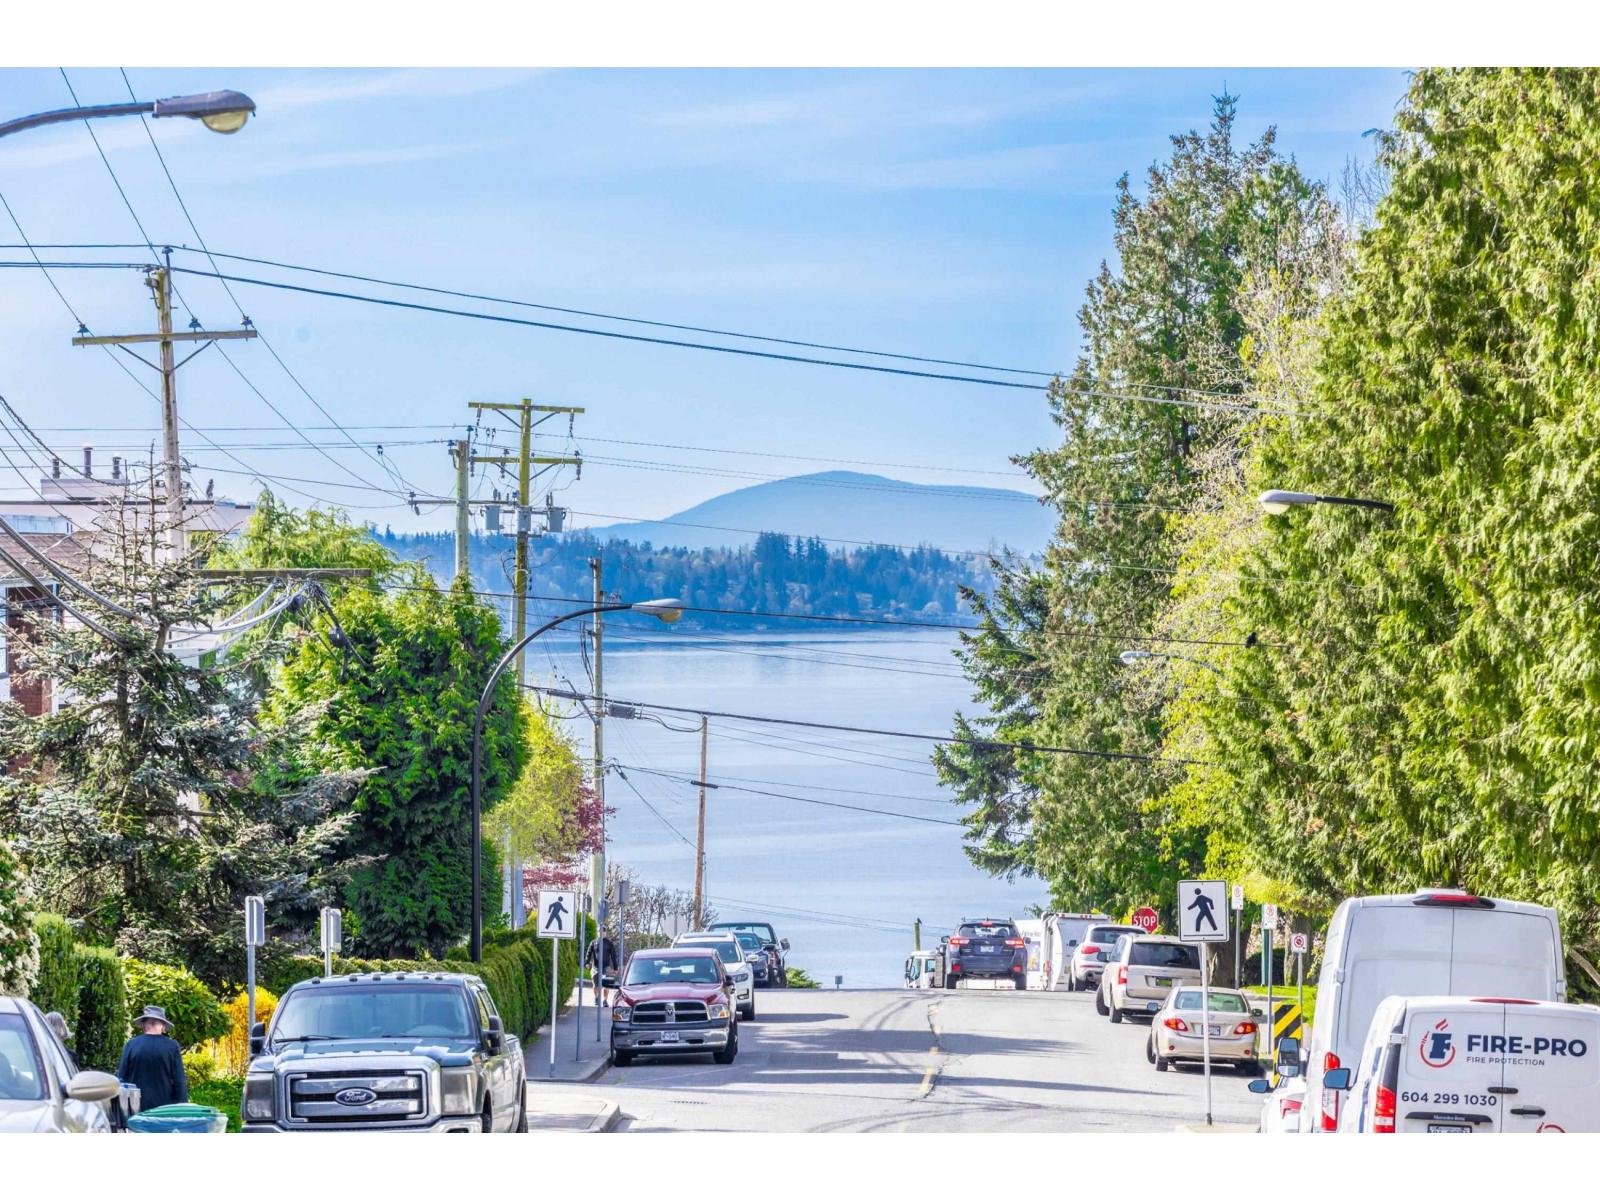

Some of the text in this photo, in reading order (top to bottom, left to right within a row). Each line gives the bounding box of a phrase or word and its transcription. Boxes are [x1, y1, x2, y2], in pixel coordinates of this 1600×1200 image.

[1133, 915, 1156, 927] STOP
[1467, 1034, 1587, 1057] FIRE-PRO
[1466, 1056, 1545, 1066] FIRE PROTECTION
[344, 1090, 367, 1102] Ford
[1401, 1091, 1497, 1106] 604 299 1030
